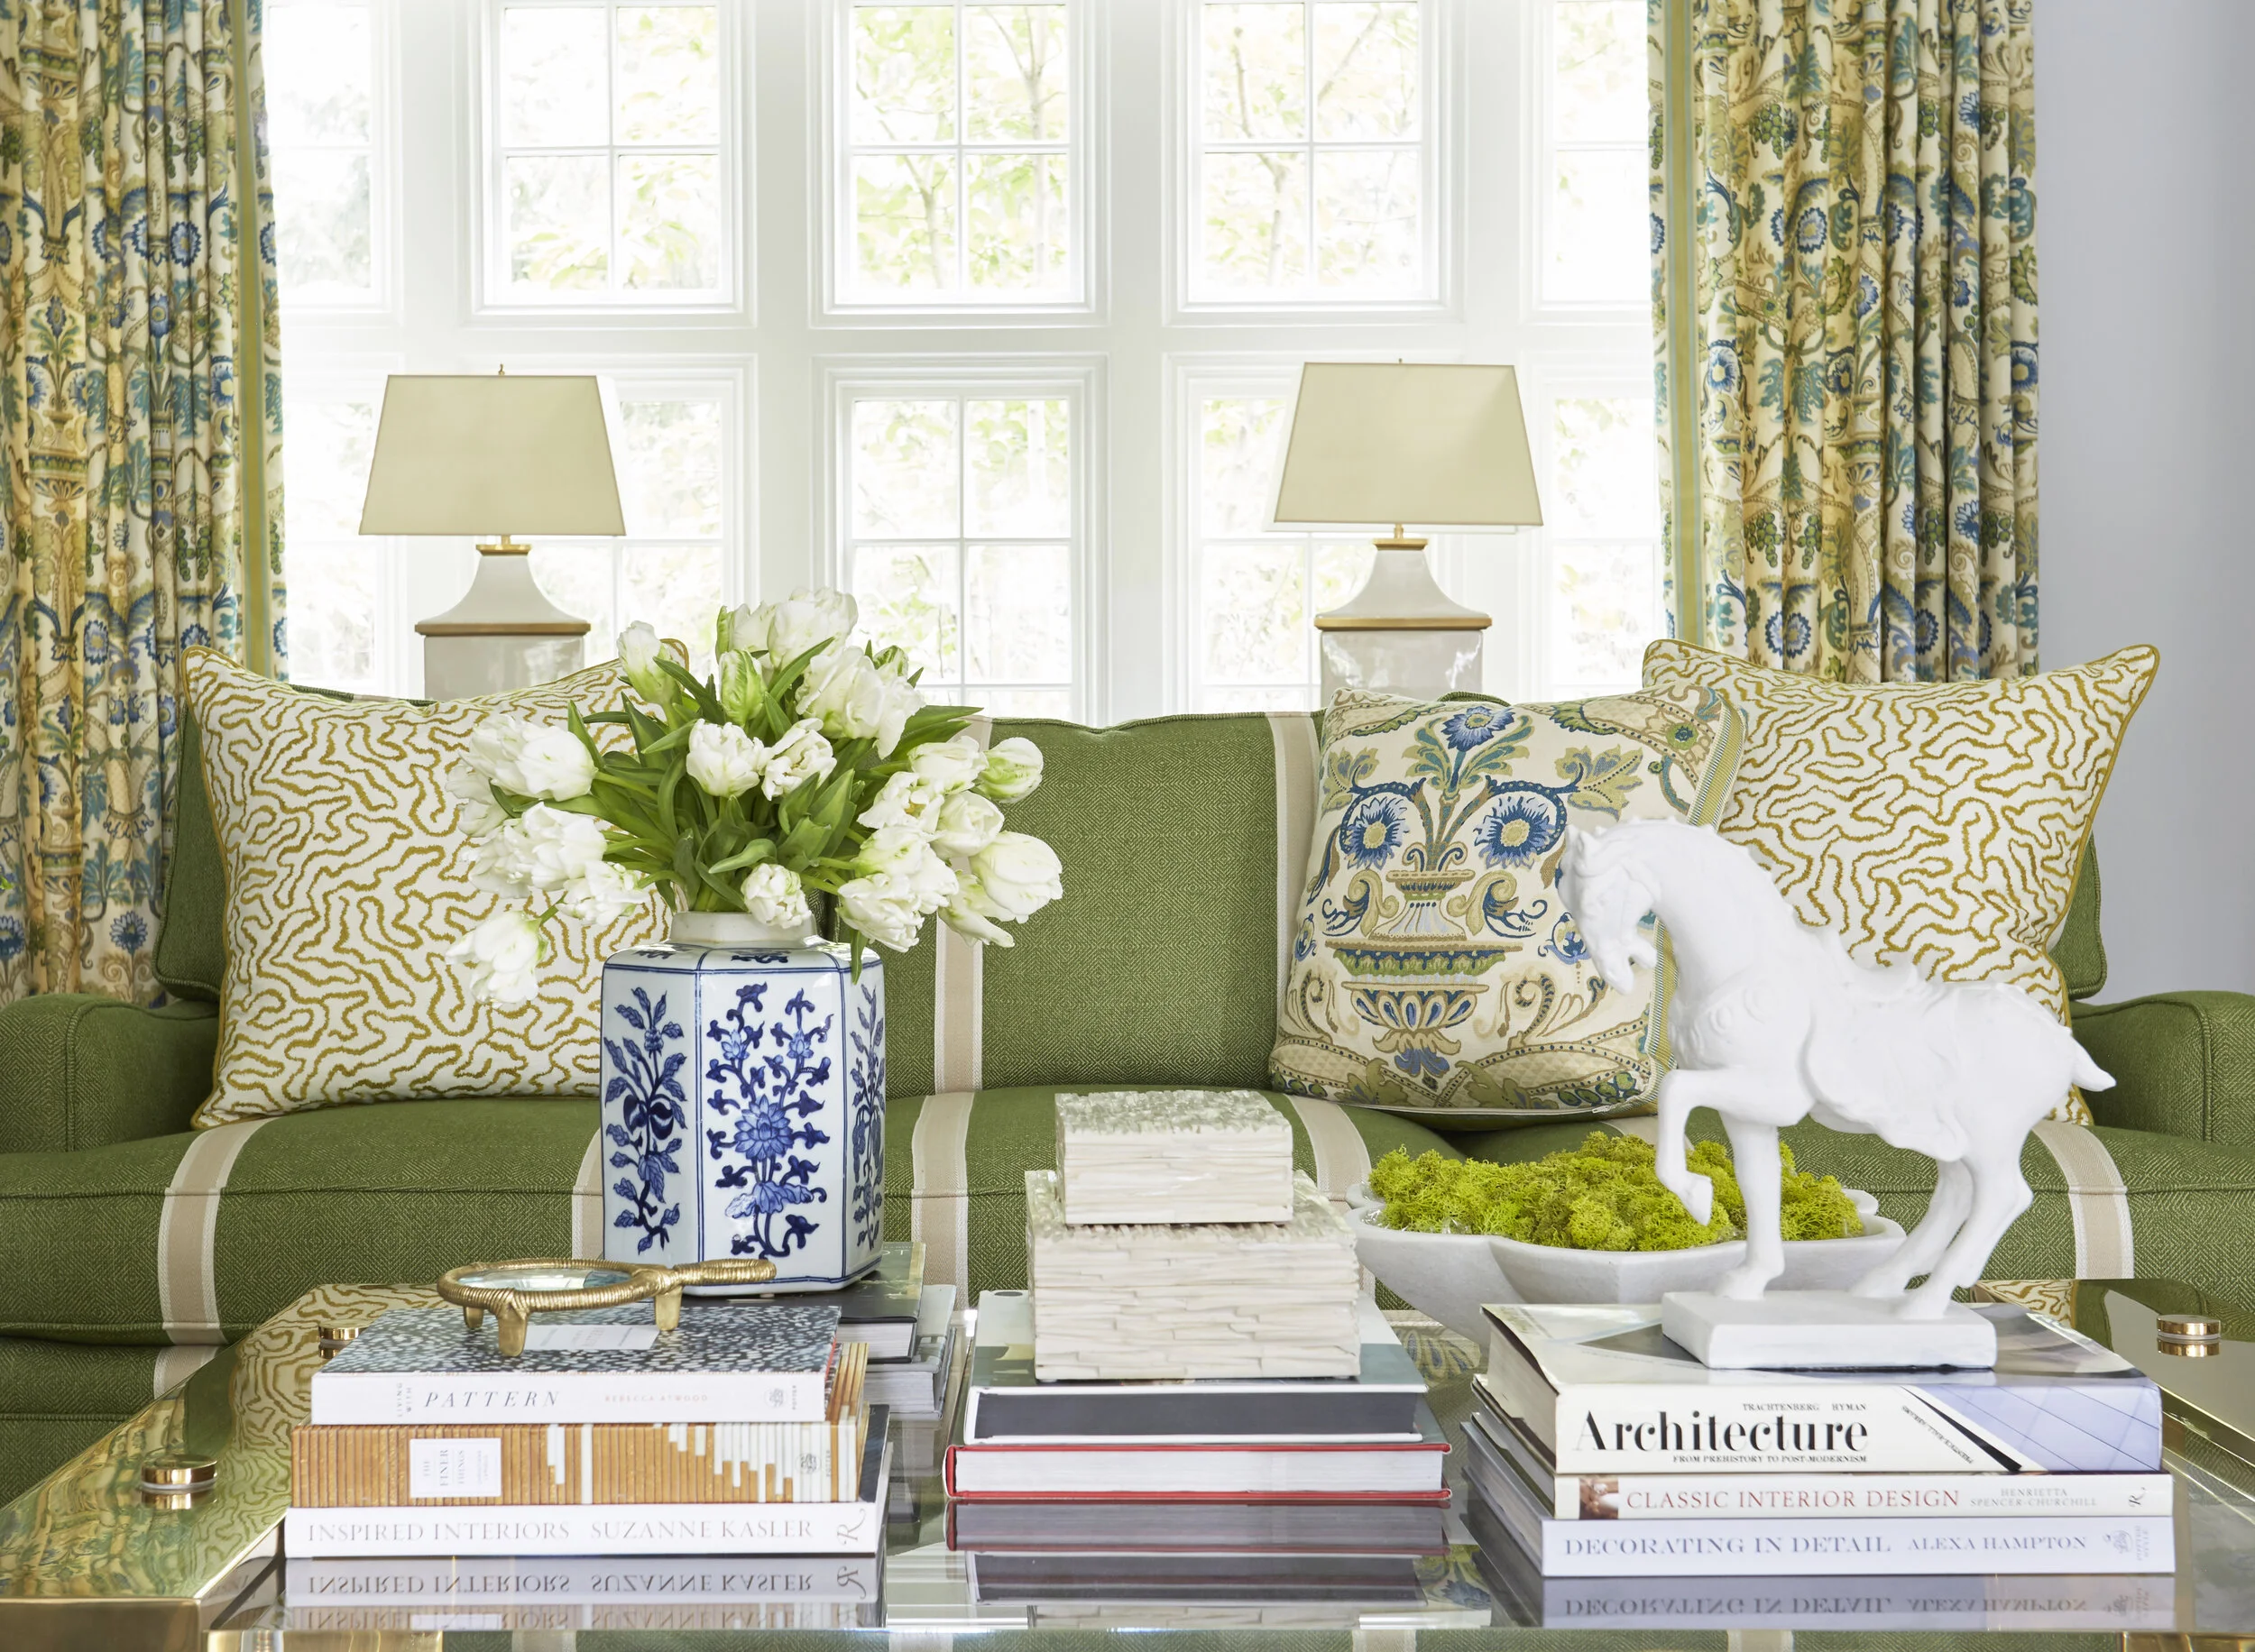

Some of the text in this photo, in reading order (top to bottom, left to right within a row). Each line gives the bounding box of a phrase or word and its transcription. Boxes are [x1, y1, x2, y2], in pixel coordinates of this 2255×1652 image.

[424, 1390, 560, 1409] PATTERN
[604, 1393, 708, 1403] REBECCA ATWOOD
[1742, 1402, 1867, 1412] TRACHTENBERG HYMAN
[1572, 1409, 1870, 1453] Architecture
[439, 1449, 449, 1487] FINER
[456, 1449, 465, 1485] THINGS
[1672, 1455, 1700, 1464] FROM
[1703, 1455, 1763, 1464] PREHISTORY
[1766, 1455, 1780, 1464] TO
[1626, 1490, 1959, 1509] CLASSIC INTERIOR DESIGN
[2000, 1487, 2069, 1498] HENRIETTA
[1969, 1497, 2098, 1508] SPENCER-CHURCHILL
[308, 1519, 812, 1542] INSPIRED INTERIORS SUZANNE KASLER
[1565, 1536, 2086, 1556] DECORATING IN DETAIL ALEXA HAMPTON
